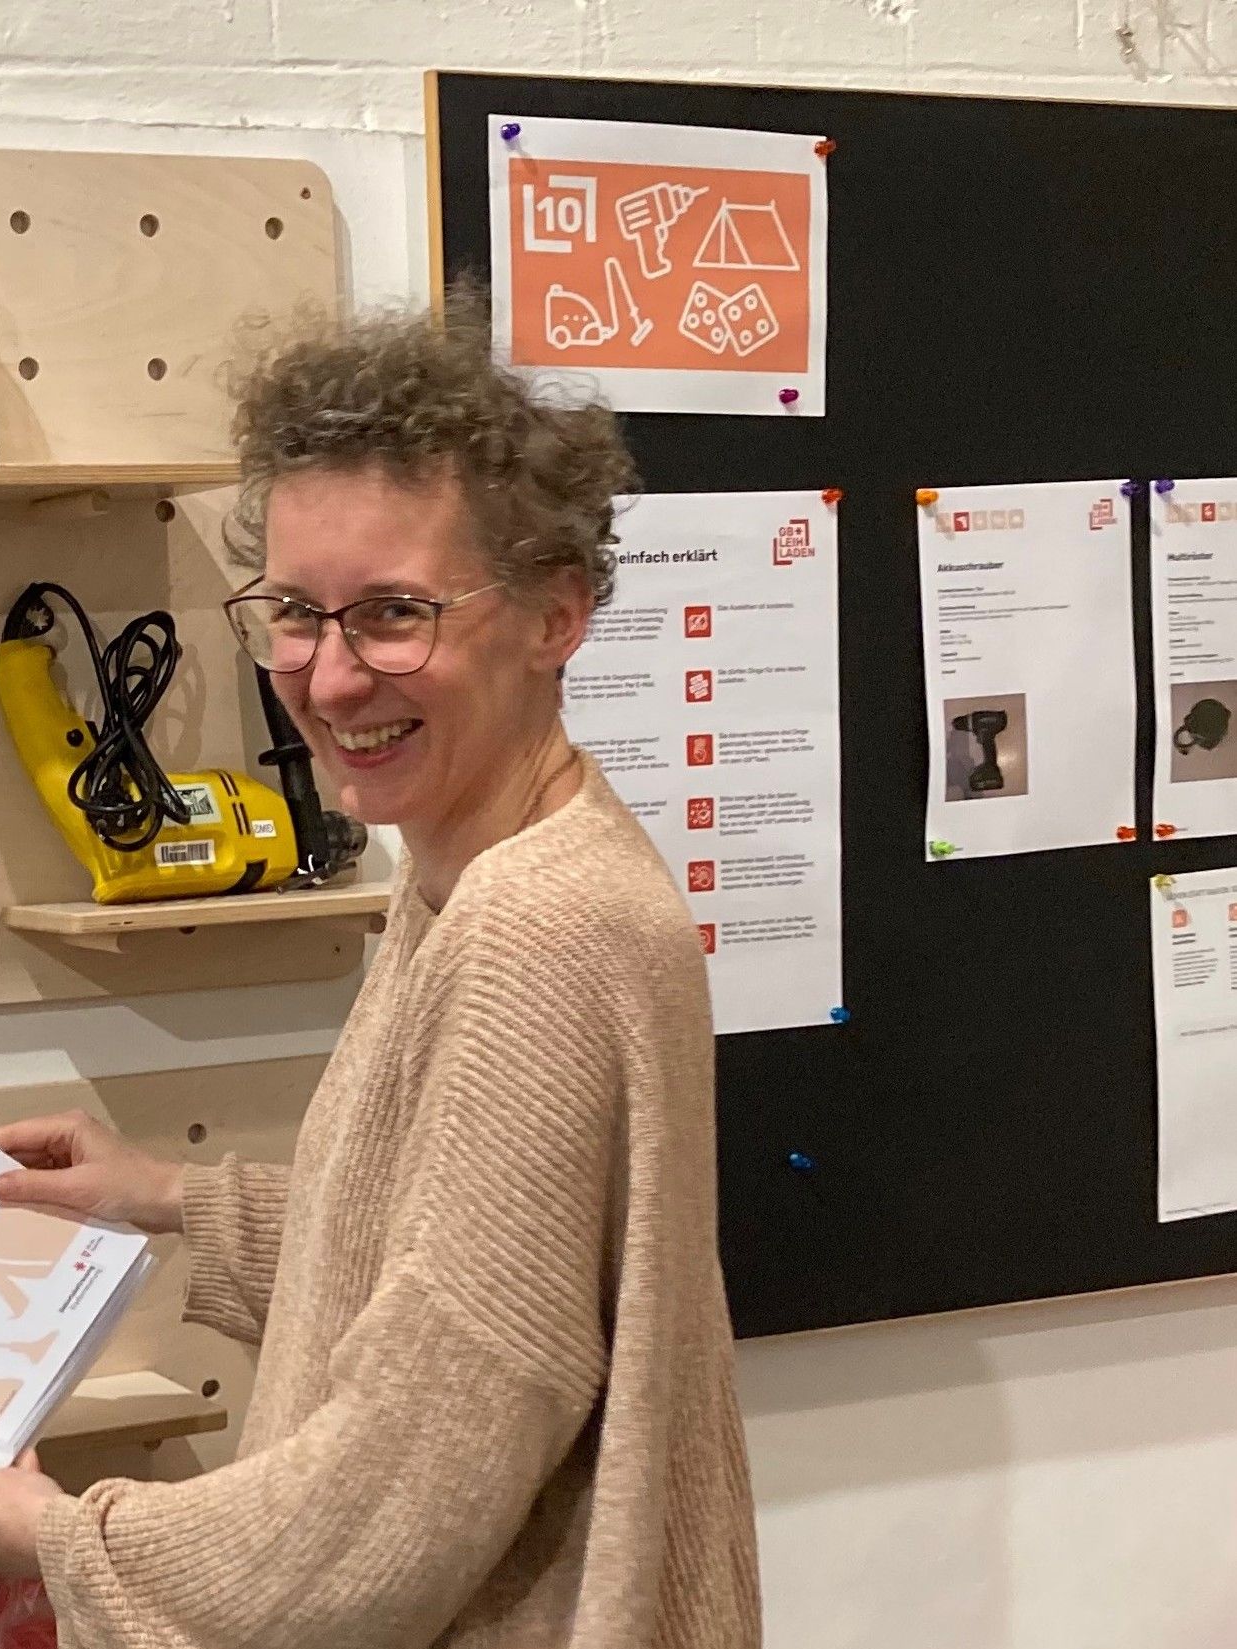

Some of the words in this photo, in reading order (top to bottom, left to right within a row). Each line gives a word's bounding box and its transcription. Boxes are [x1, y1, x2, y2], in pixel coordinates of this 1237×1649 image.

[536, 195, 583, 234] 10
[779, 537, 805, 547] LEIH
[618, 551, 670, 564] einfach
[672, 549, 719, 563] erklärt
[779, 547, 816, 558] LADEN
